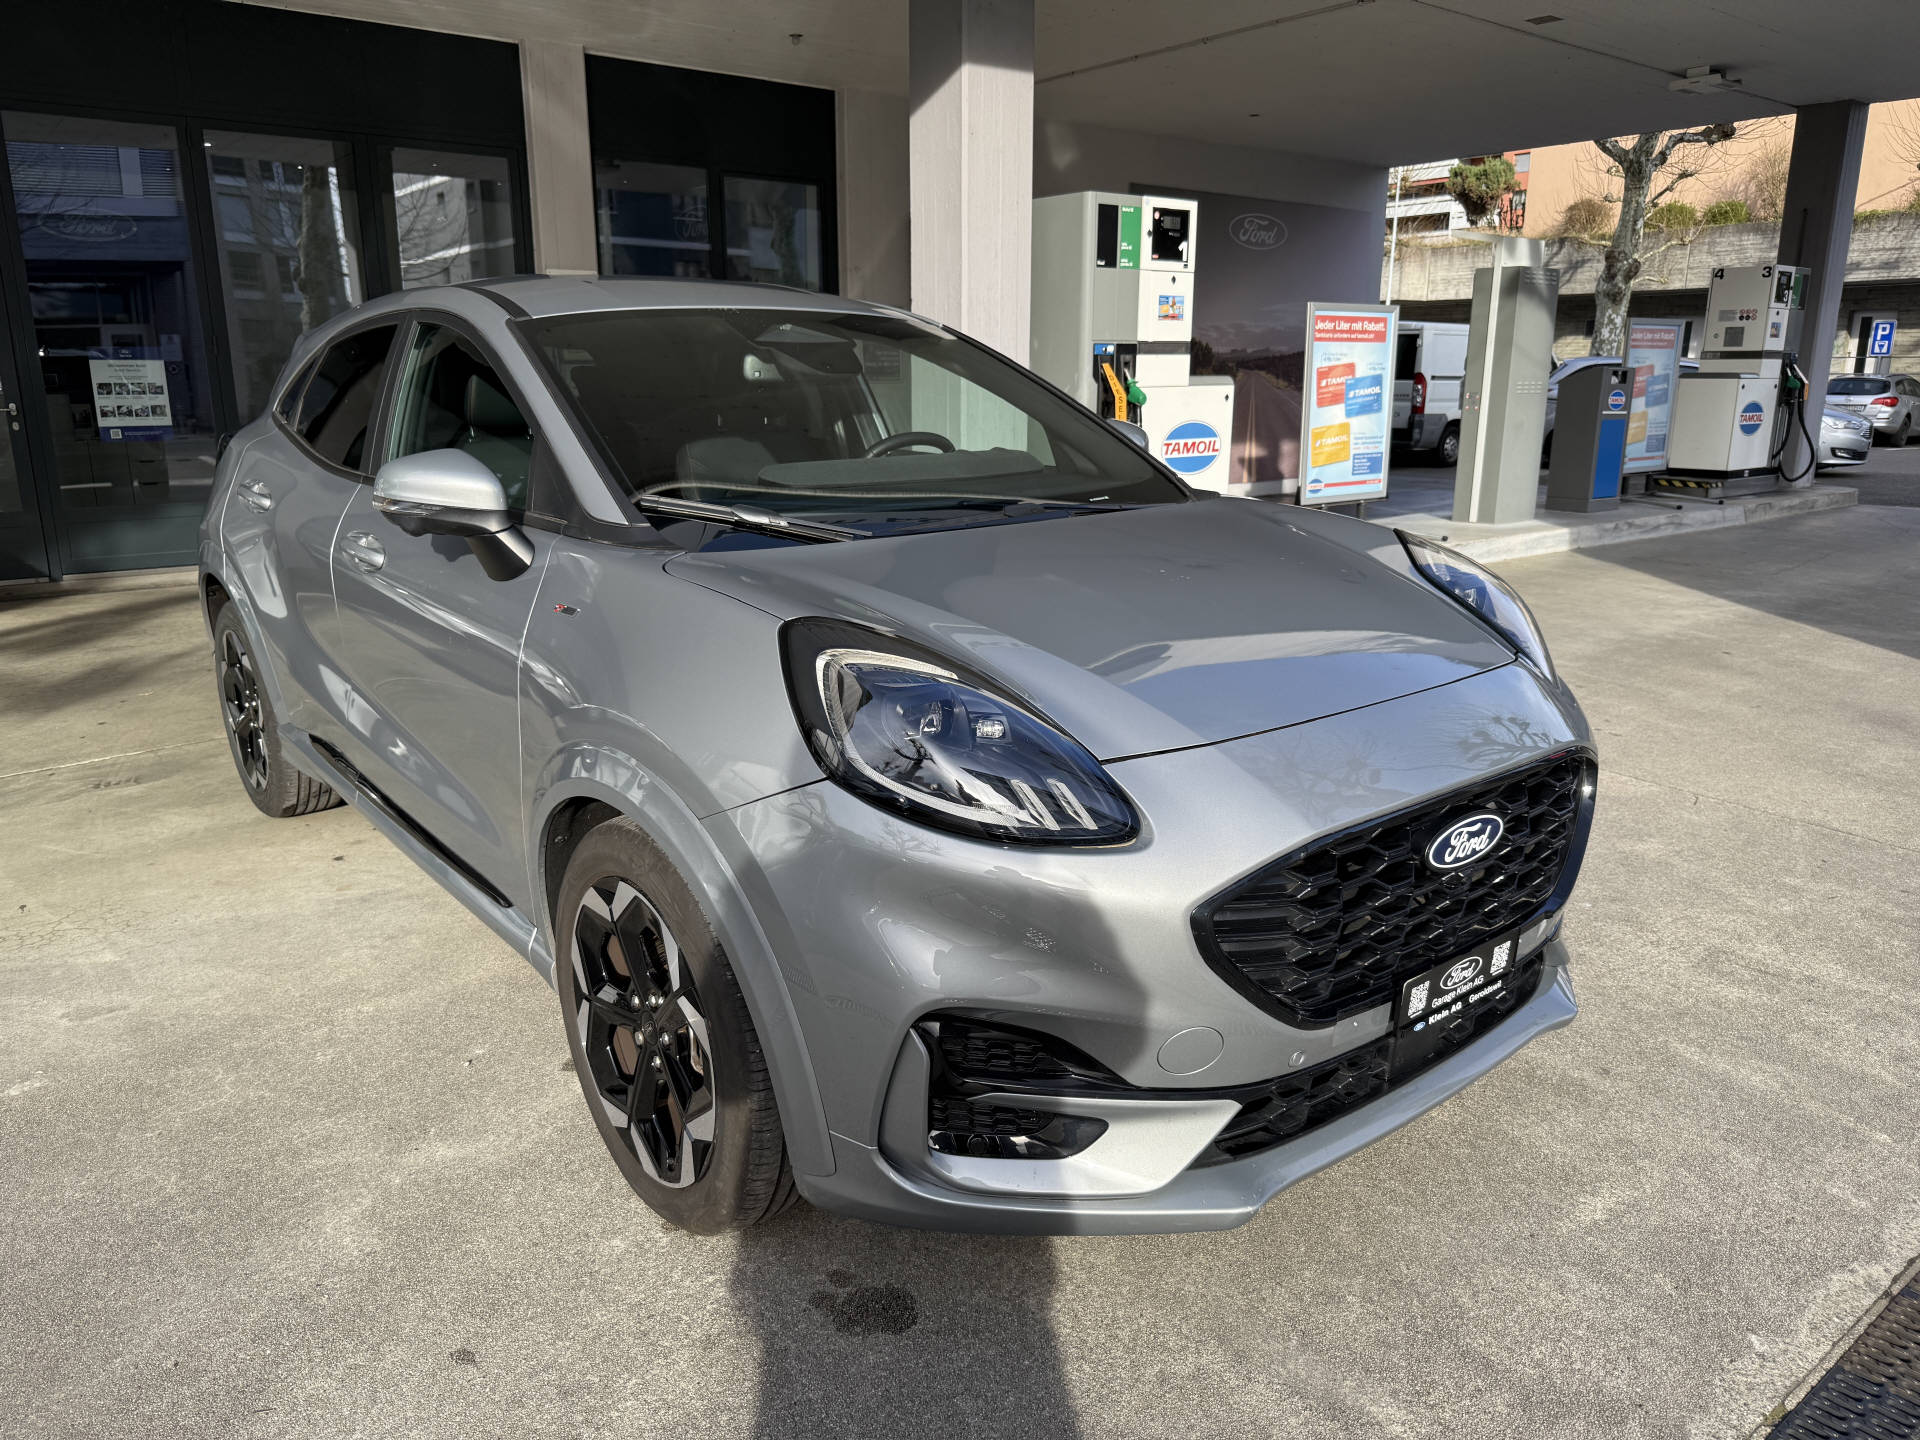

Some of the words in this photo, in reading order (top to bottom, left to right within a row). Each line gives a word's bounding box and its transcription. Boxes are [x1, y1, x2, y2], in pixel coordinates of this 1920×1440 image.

[1239, 217, 1278, 244] Ford
[1178, 240, 1188, 262] 1
[1714, 268, 1725, 280] 4
[1761, 266, 1772, 278] 3
[1783, 290, 1789, 302] 3
[1315, 319, 1335, 330] Jeder
[1335, 320, 1351, 331] Liter
[1351, 321, 1363, 331] mit
[1877, 323, 1891, 341] P
[1740, 413, 1764, 423] TAMOIL
[1163, 439, 1219, 456] TAMOIL
[1444, 822, 1491, 863] Ford
[1447, 962, 1476, 986] Ford
[1432, 991, 1456, 1008] Garage
[1456, 982, 1474, 994] Klein
[1473, 975, 1484, 985] AG
[1469, 980, 1502, 1002] Geroldswil
[1428, 1010, 1449, 1024] Klein
[1450, 1002, 1462, 1013] AG
